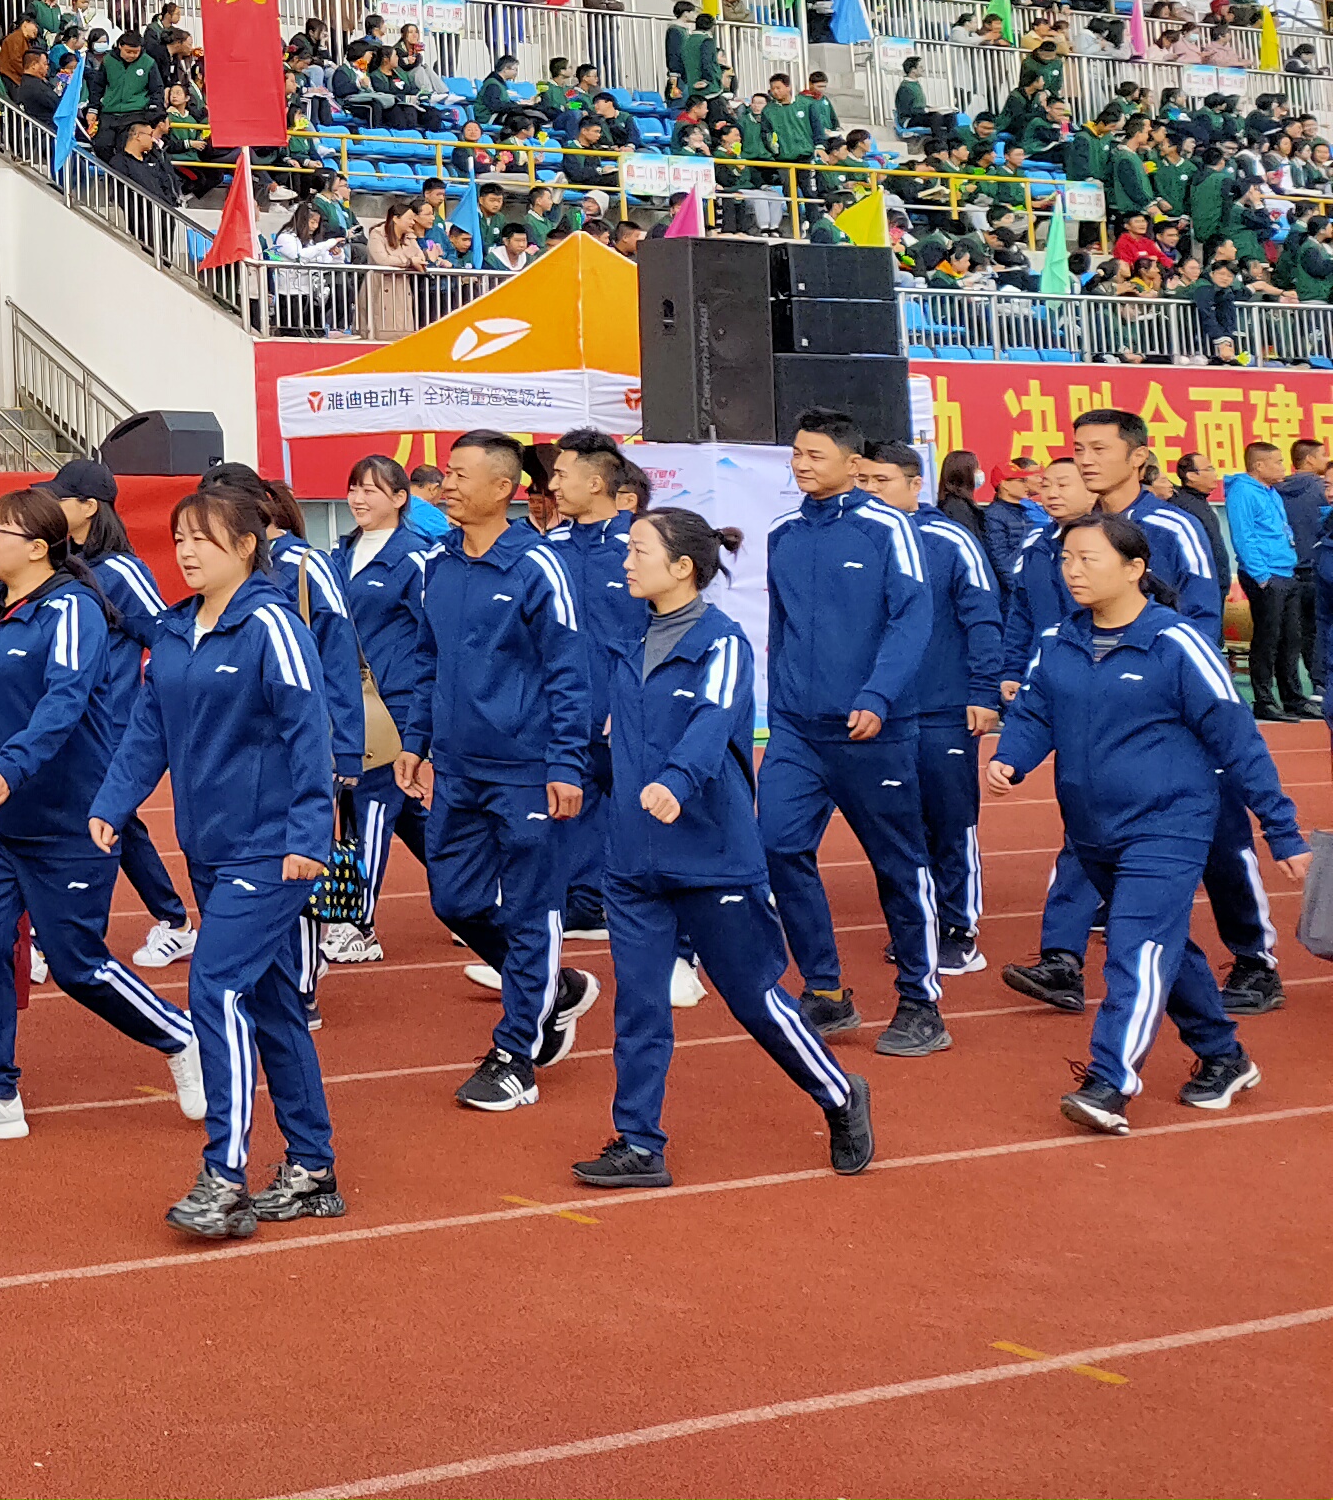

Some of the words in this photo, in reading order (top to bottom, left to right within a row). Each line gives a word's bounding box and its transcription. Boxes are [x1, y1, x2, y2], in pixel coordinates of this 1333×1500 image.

[327, 387, 415, 411] 雅迪电动车
